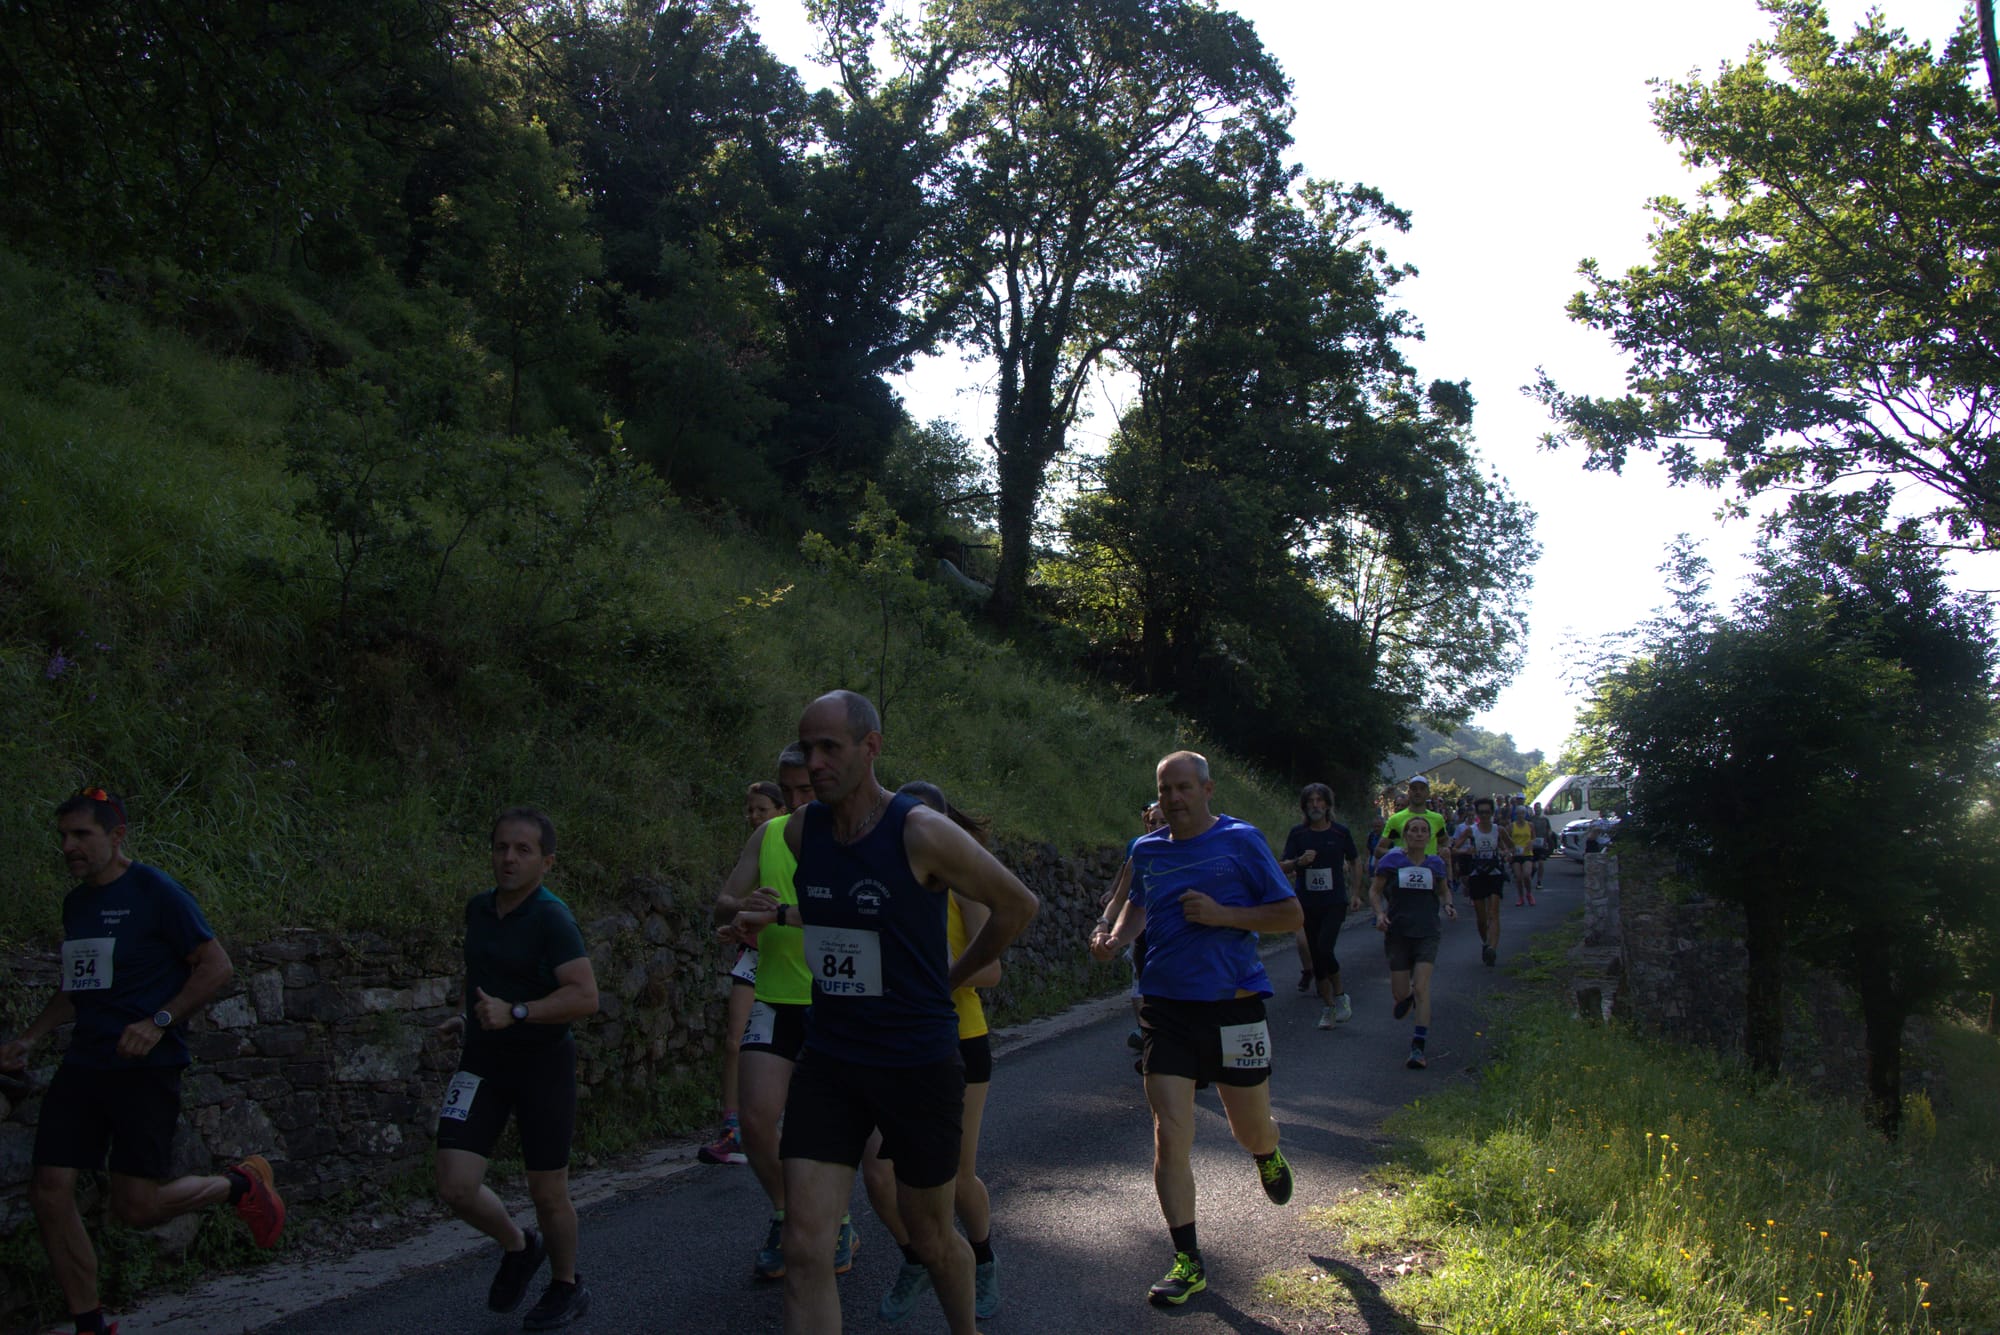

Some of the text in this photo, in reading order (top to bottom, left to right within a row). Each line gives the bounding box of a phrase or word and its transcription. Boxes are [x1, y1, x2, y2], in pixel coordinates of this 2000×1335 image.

[1312, 877, 1325, 886] 46
[1409, 874, 1424, 883] 22
[74, 959, 96, 978] 54
[823, 954, 856, 979] 84
[1242, 1041, 1265, 1057] 36
[447, 1089, 460, 1105] 3
